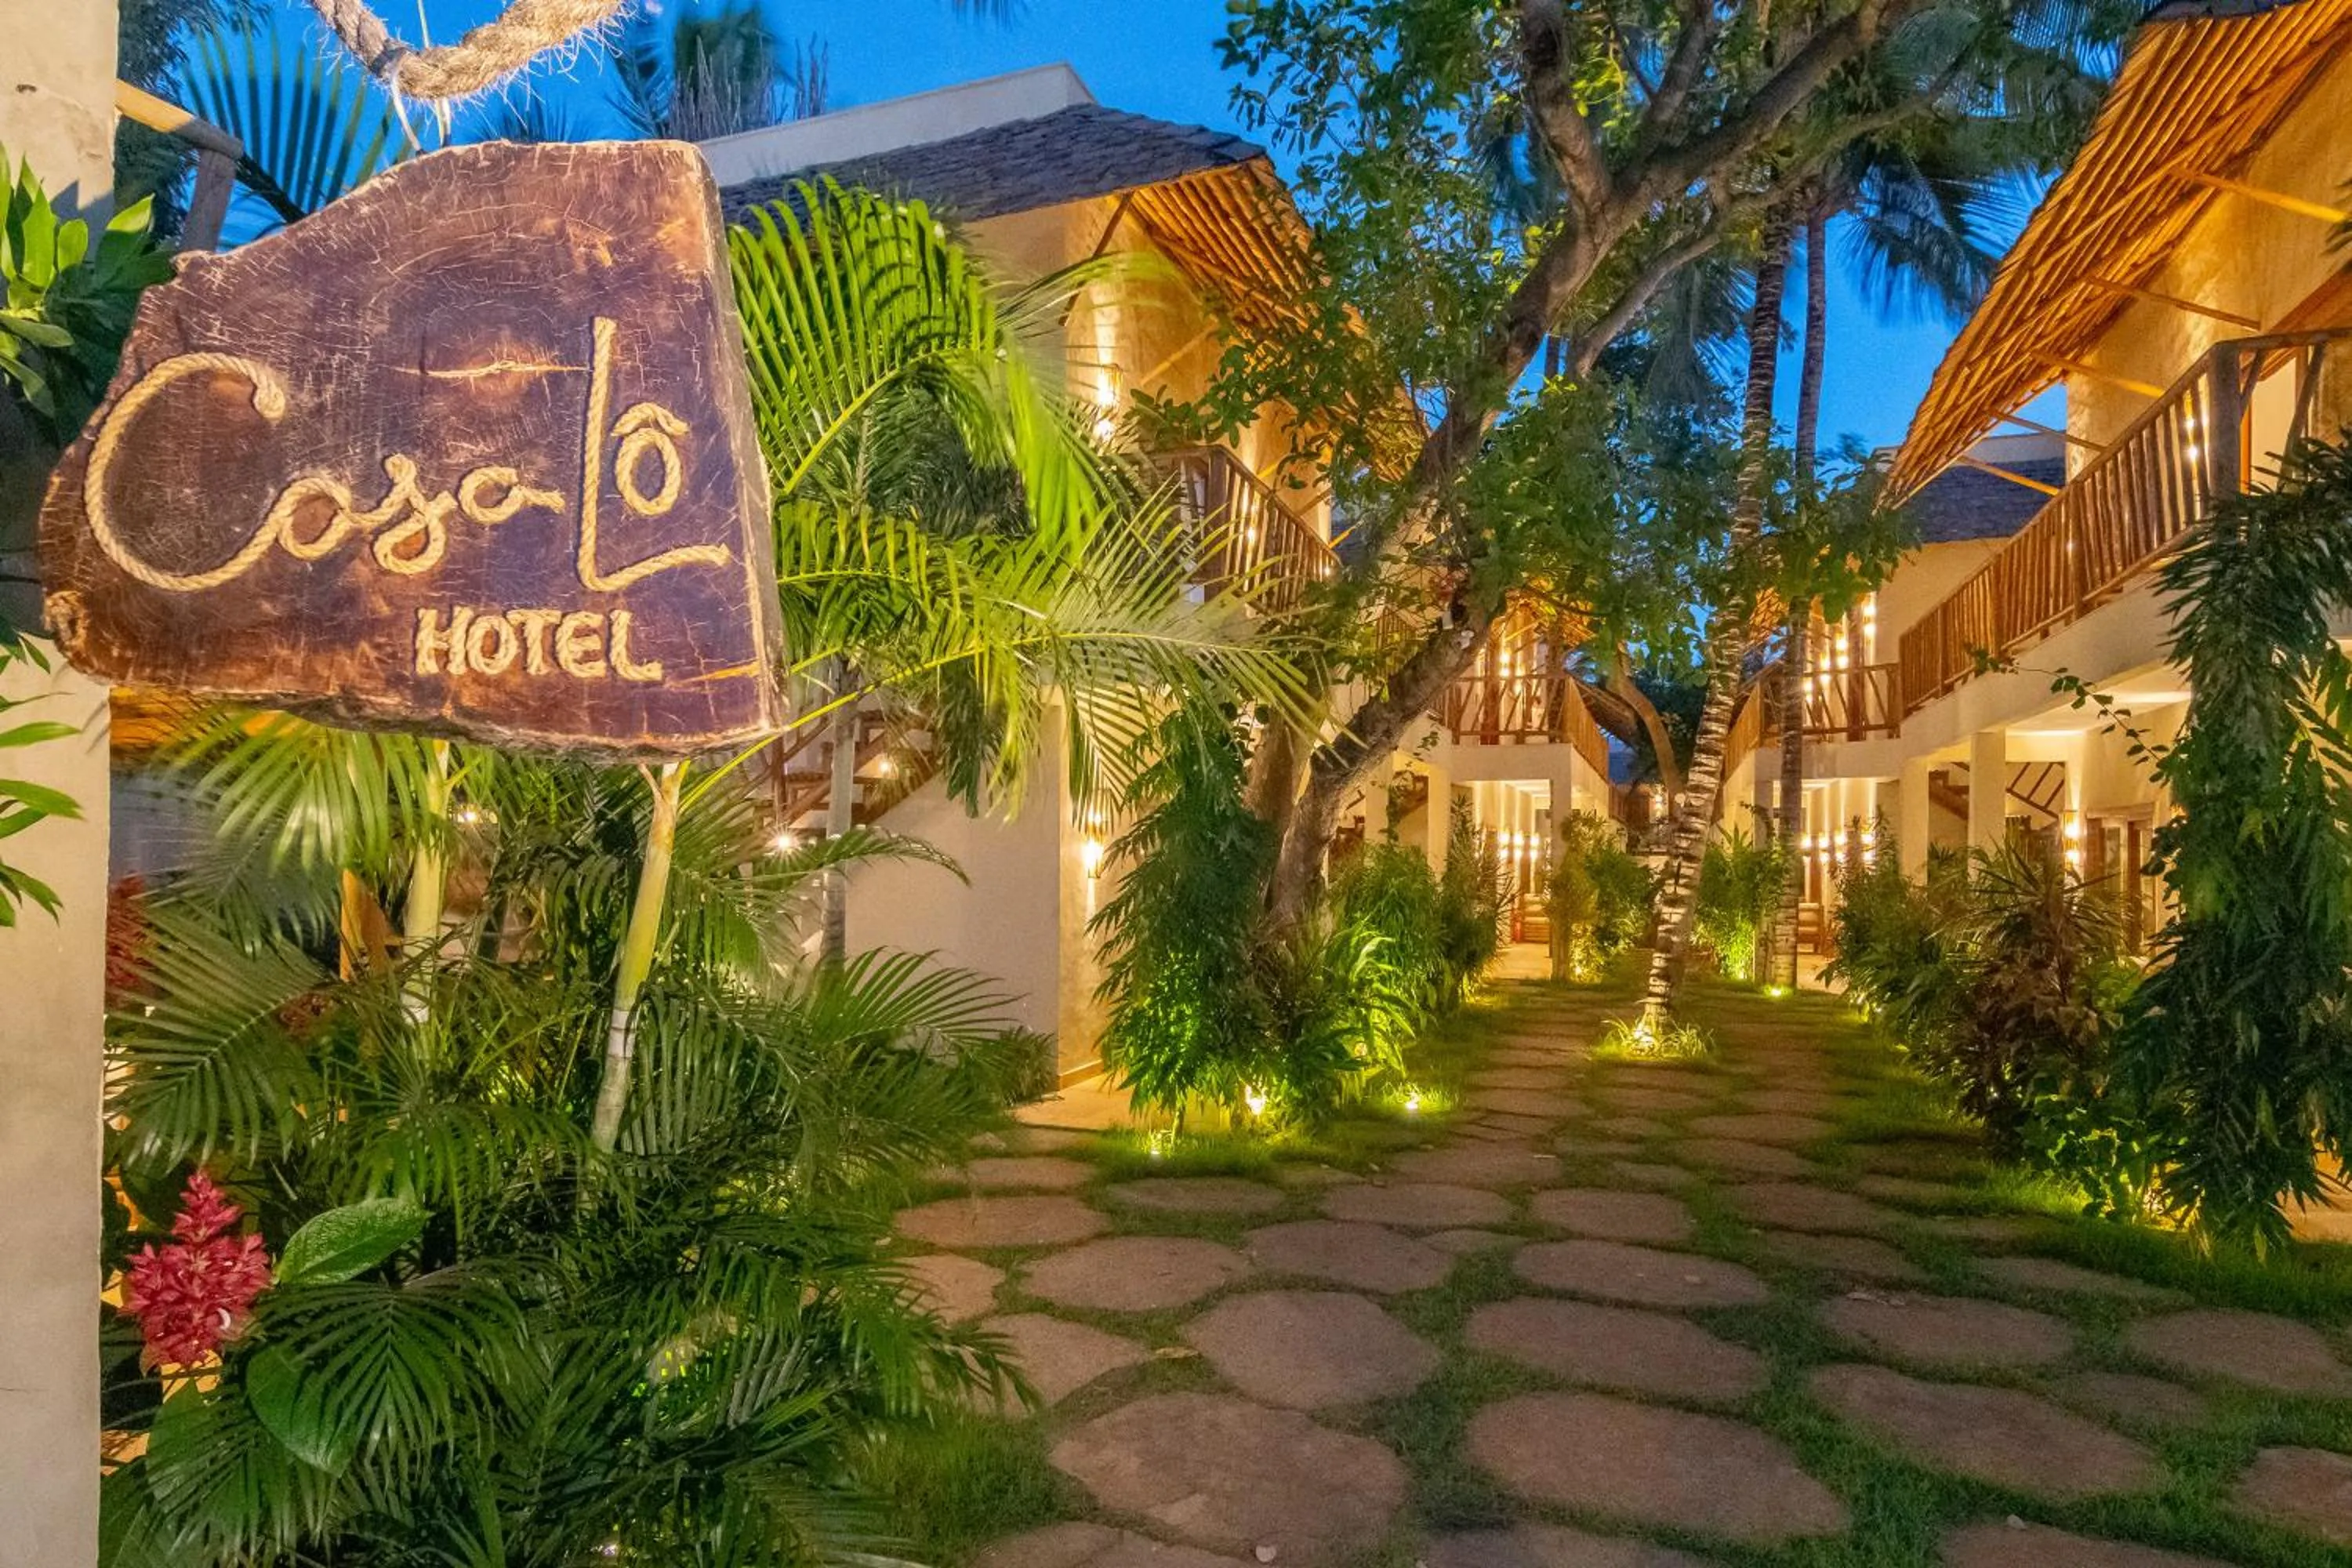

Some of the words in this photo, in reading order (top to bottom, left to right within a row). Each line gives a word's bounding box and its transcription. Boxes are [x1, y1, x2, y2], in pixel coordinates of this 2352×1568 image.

[84, 351, 566, 592] Casa
[577, 317, 732, 592] Lô
[414, 606, 662, 681] HOTEL
